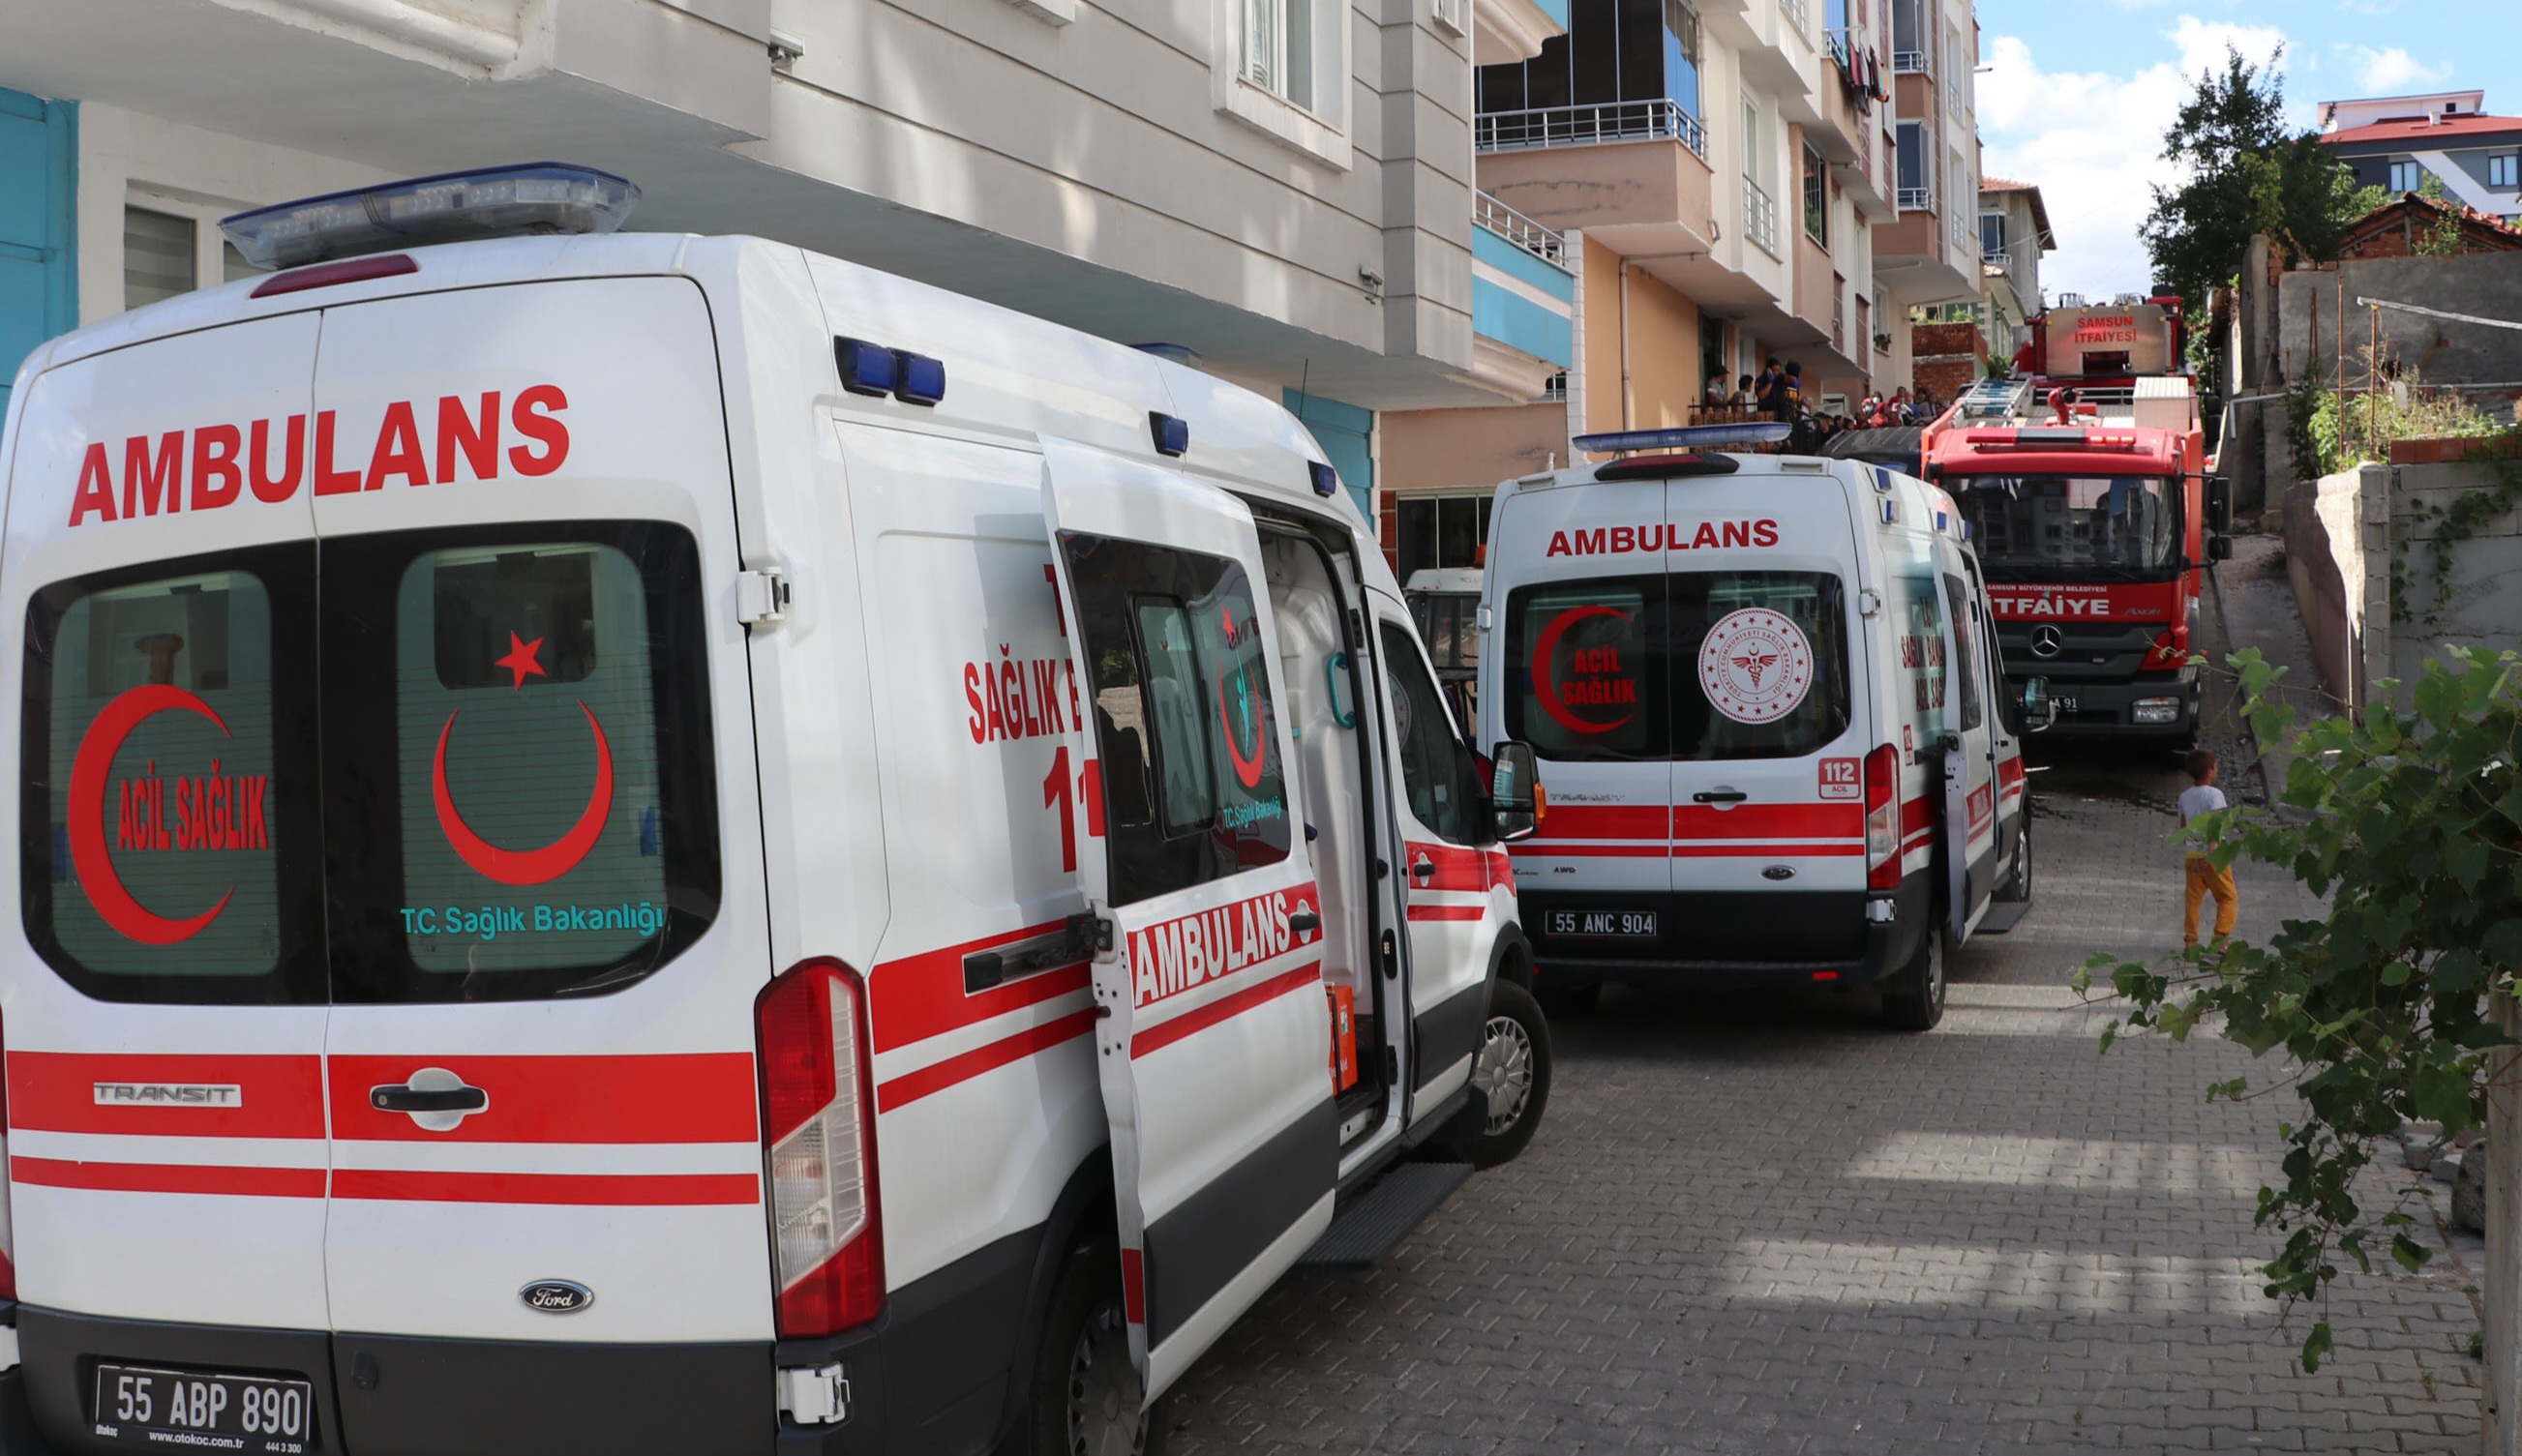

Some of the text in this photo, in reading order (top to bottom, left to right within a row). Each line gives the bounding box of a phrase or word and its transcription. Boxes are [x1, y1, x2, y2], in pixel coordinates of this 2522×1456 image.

[2078, 315, 2133, 328] SAMSUN
[2075, 329, 2137, 343] İTFAİYESİ
[68, 384, 570, 527] AMBULANS
[1546, 520, 1779, 557] AMBULANS
[964, 642, 1064, 745] SAĞLIK
[1562, 675, 1636, 706] SAĞLIK
[2064, 698, 2077, 708] 91
[1824, 762, 1854, 782] 112
[176, 758, 268, 850] SAĞLIK
[1553, 864, 1576, 874] AWD
[401, 902, 664, 940] T.C. Sağlık Bakanlığı
[1556, 913, 1654, 934] 55 ANC 904
[1135, 891, 1291, 1007] AMBULANS
[95, 1085, 235, 1104] TRANSIT
[532, 1288, 574, 1308] Ford
[117, 1375, 301, 1437] 55 ABP 890
[149, 1430, 245, 1449] www.otokoc.com.tr
[265, 1440, 280, 1453] 444
[281, 1441, 286, 1452] 3
